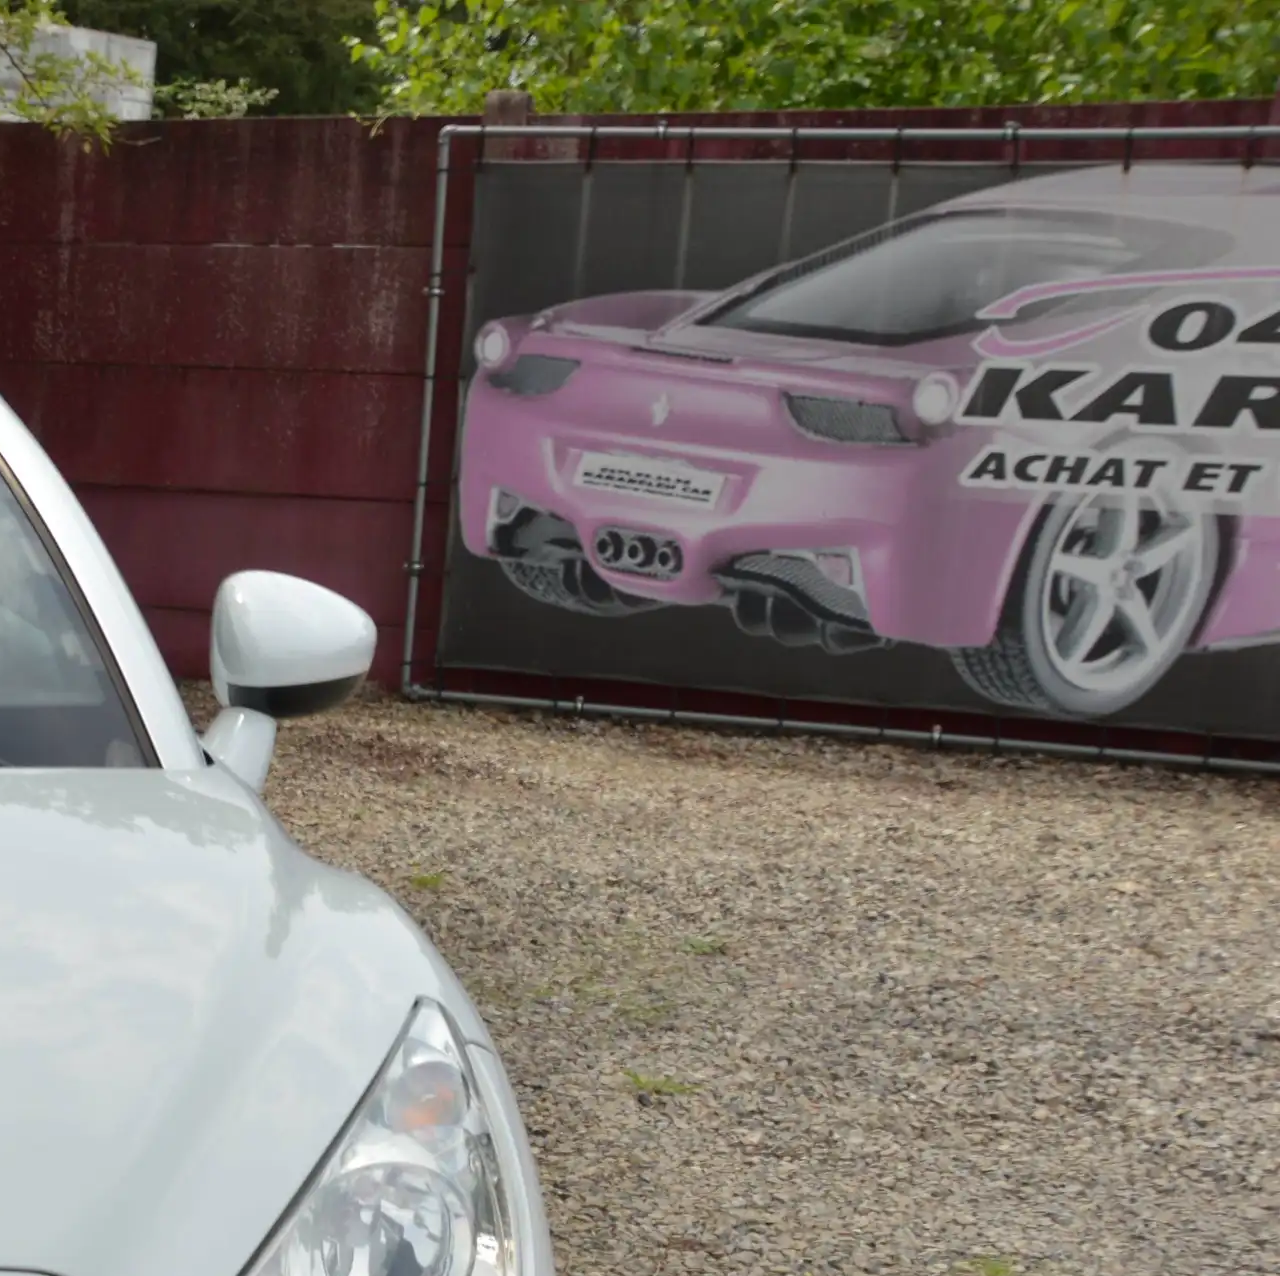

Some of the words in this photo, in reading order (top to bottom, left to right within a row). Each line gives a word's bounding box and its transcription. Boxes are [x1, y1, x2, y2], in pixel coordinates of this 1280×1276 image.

[961, 366, 1280, 430] KAR
[967, 451, 1169, 489] ACHAT
[1182, 462, 1264, 493] ET
